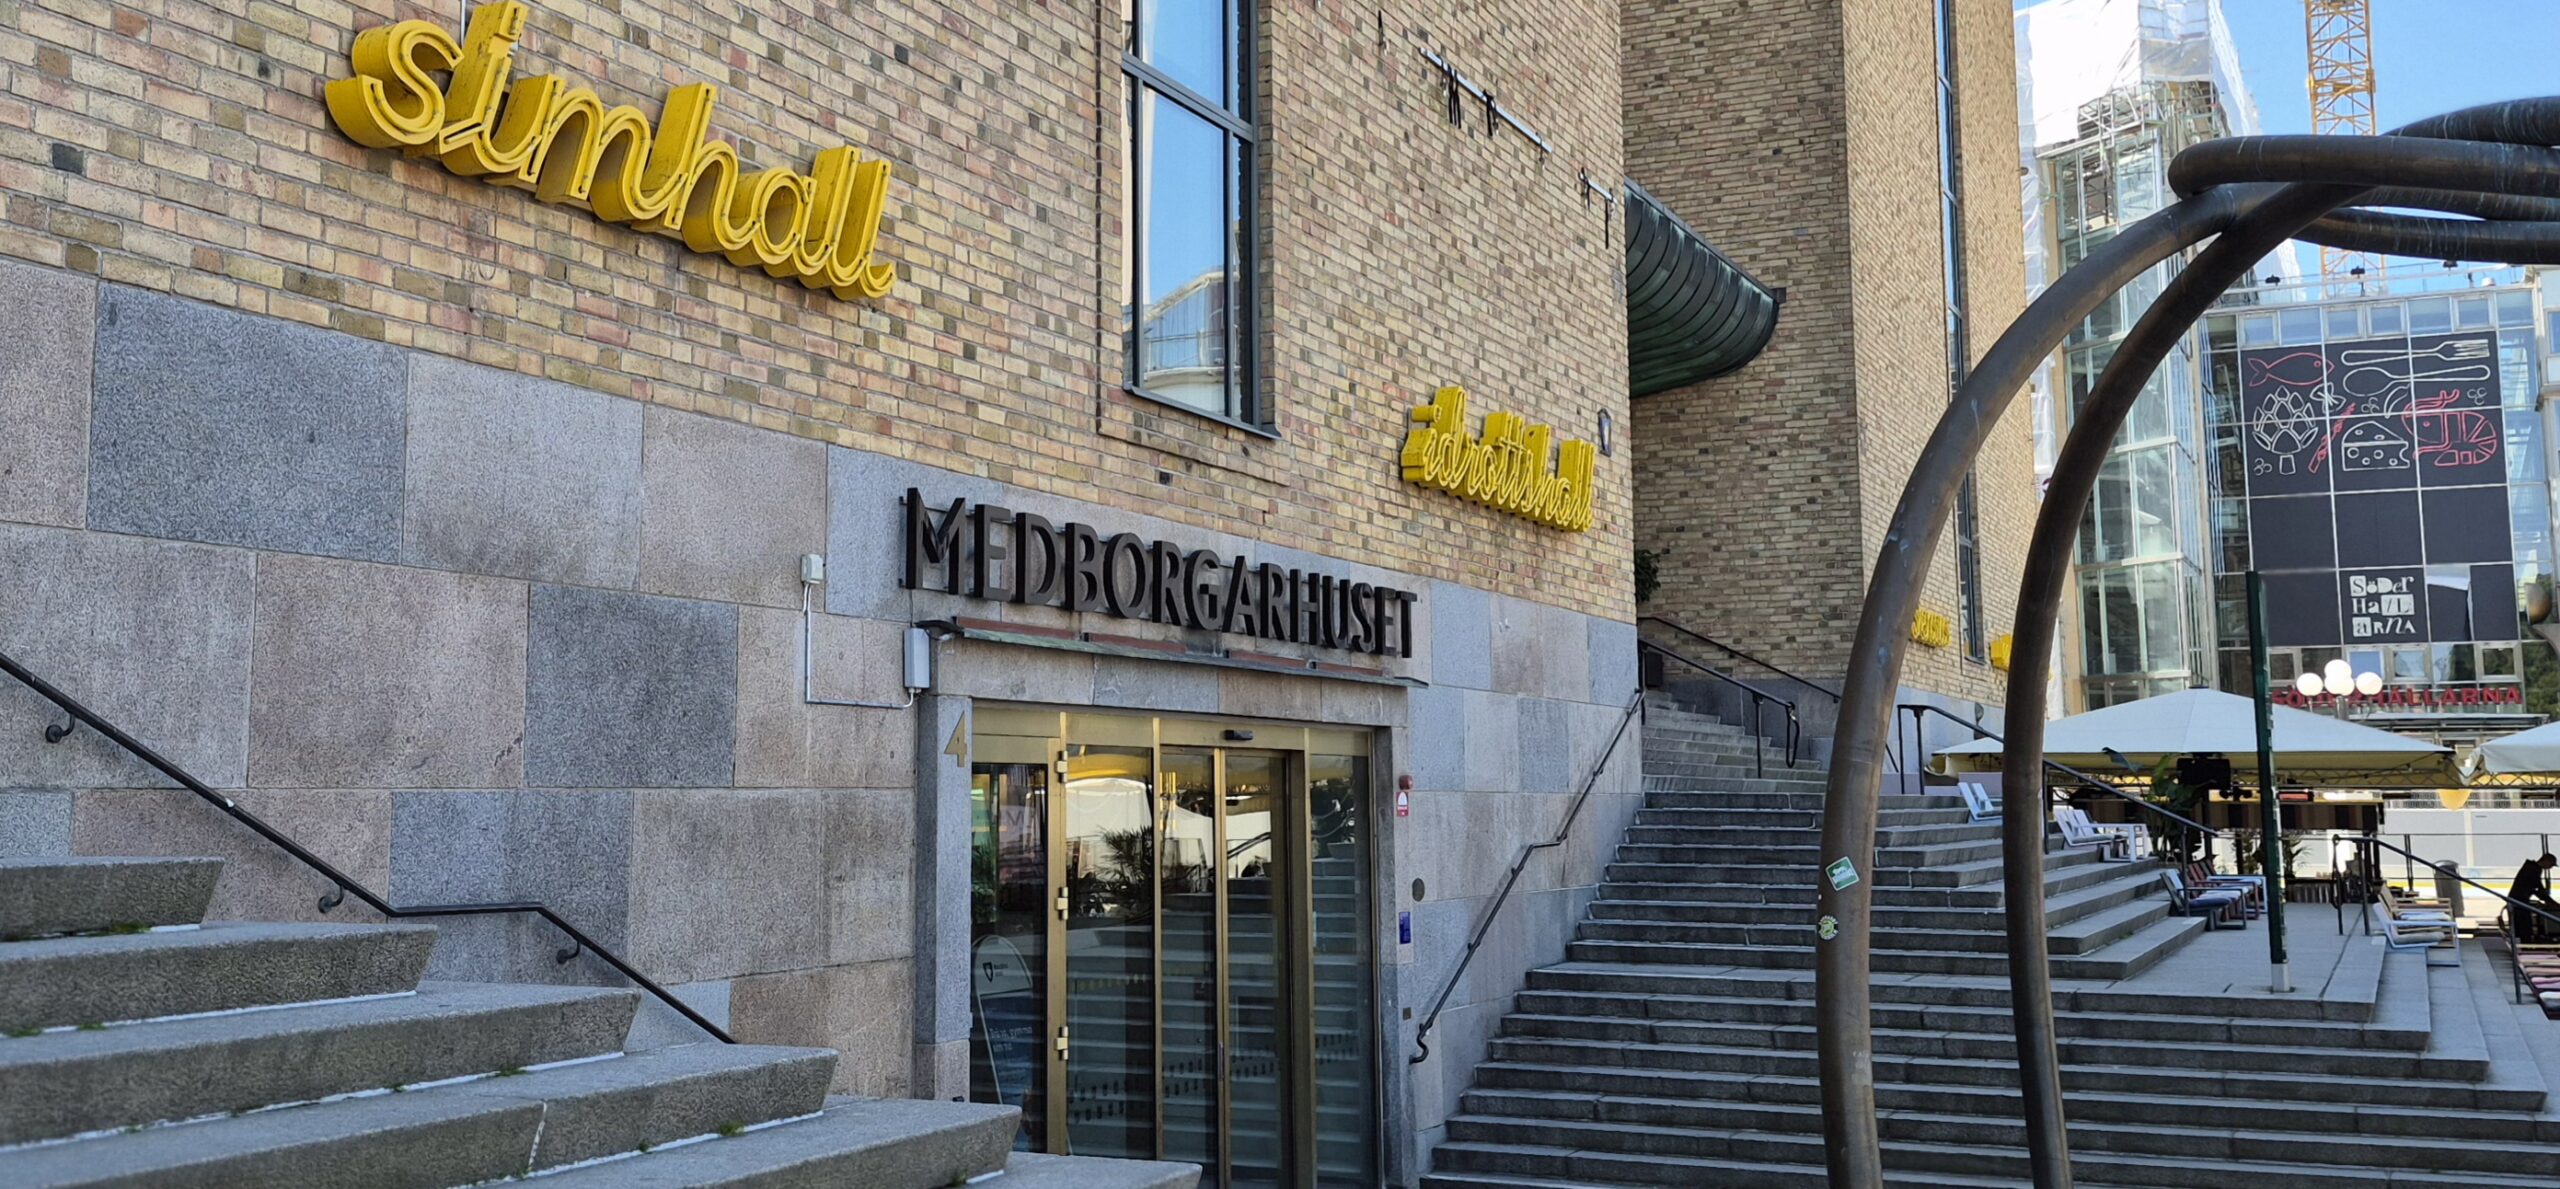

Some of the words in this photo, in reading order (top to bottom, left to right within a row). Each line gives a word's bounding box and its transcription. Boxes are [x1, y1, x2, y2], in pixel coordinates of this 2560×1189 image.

[325, 0, 896, 300] simhall
[1402, 386, 1596, 532] idrottshall
[906, 487, 1418, 659] MEDBORGARHUSET
[944, 710, 968, 768] 4
